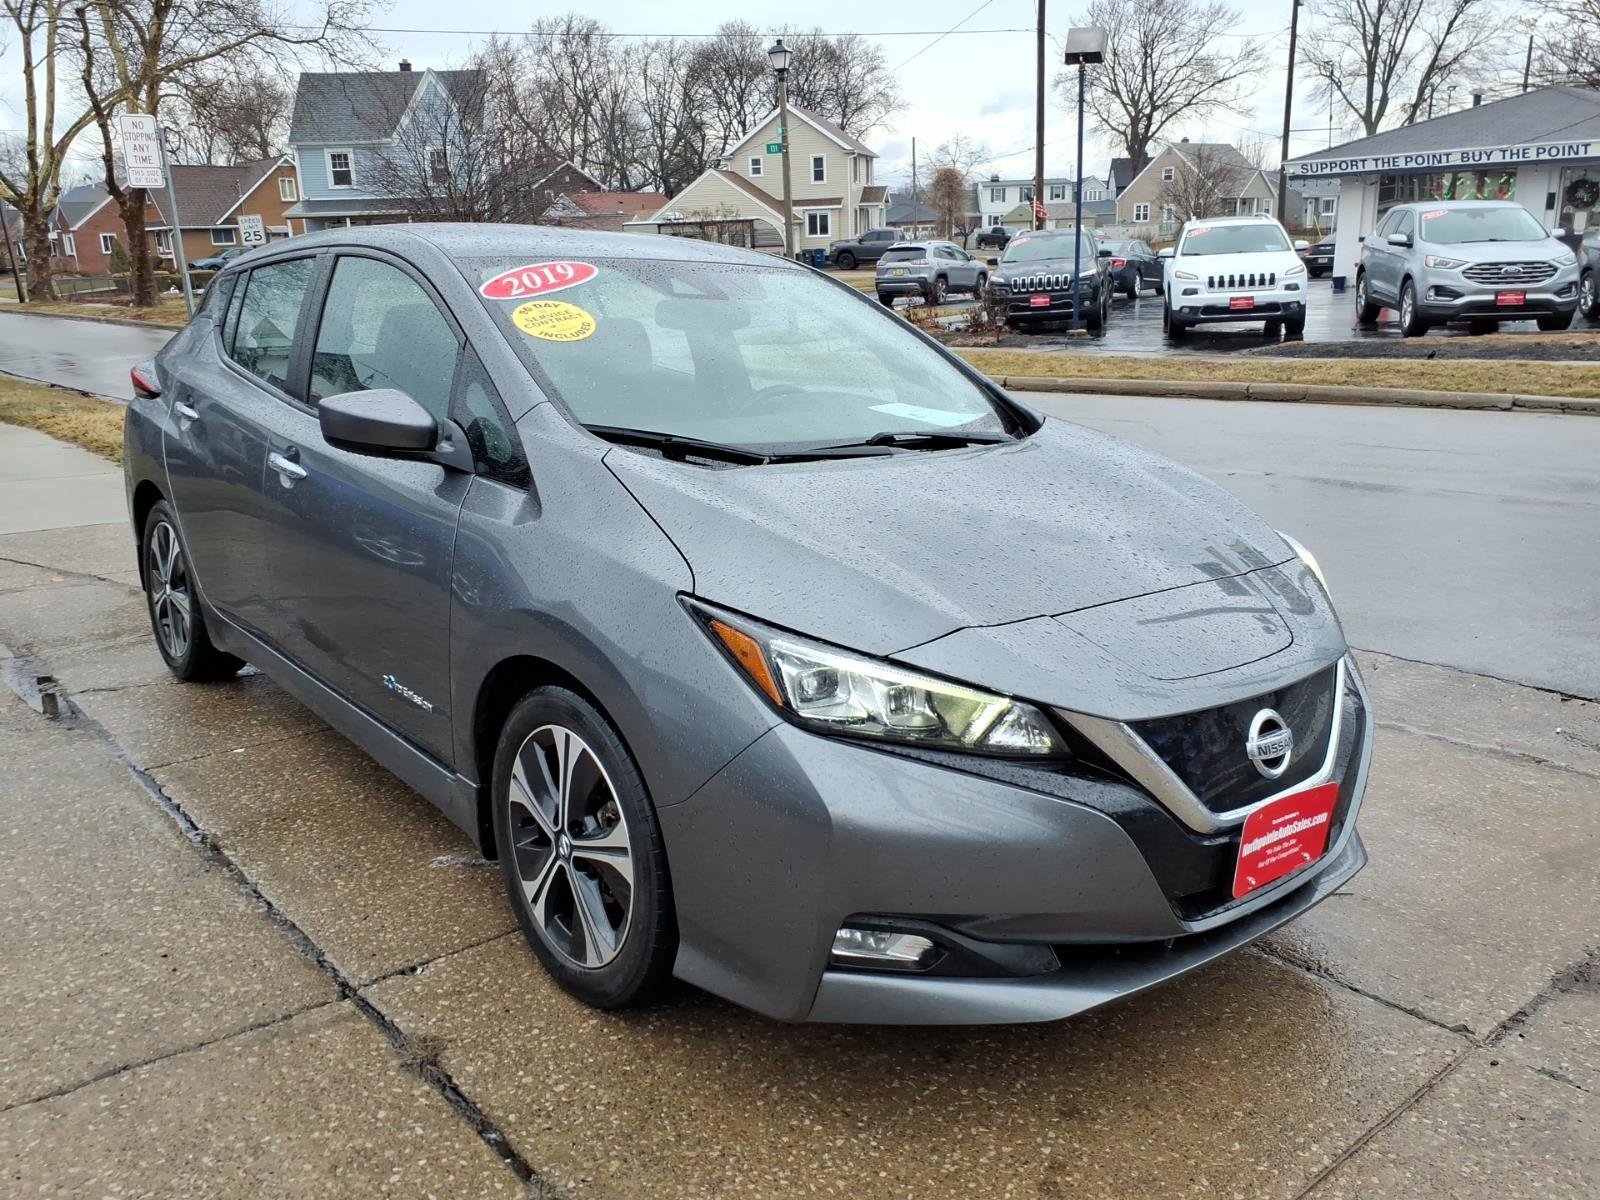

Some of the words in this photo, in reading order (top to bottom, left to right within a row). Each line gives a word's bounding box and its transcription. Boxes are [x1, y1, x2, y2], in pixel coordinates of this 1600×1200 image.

[132, 120, 145, 130] NO
[123, 132, 156, 142] STOPPING
[133, 144, 150, 152] ANY
[134, 155, 154, 165] TIME
[1300, 159, 1368, 174] SUPPORT
[1373, 156, 1400, 169] THE
[1404, 153, 1453, 166] POINT
[1460, 150, 1494, 163] BUY
[1500, 147, 1531, 160] THE
[1536, 143, 1592, 159] POINT
[243, 231, 263, 242] 25
[502, 263, 575, 296] 2019
[524, 309, 574, 324] SERVICE
[524, 313, 584, 329] CONTRACT
[538, 320, 592, 340] INCLUDED
